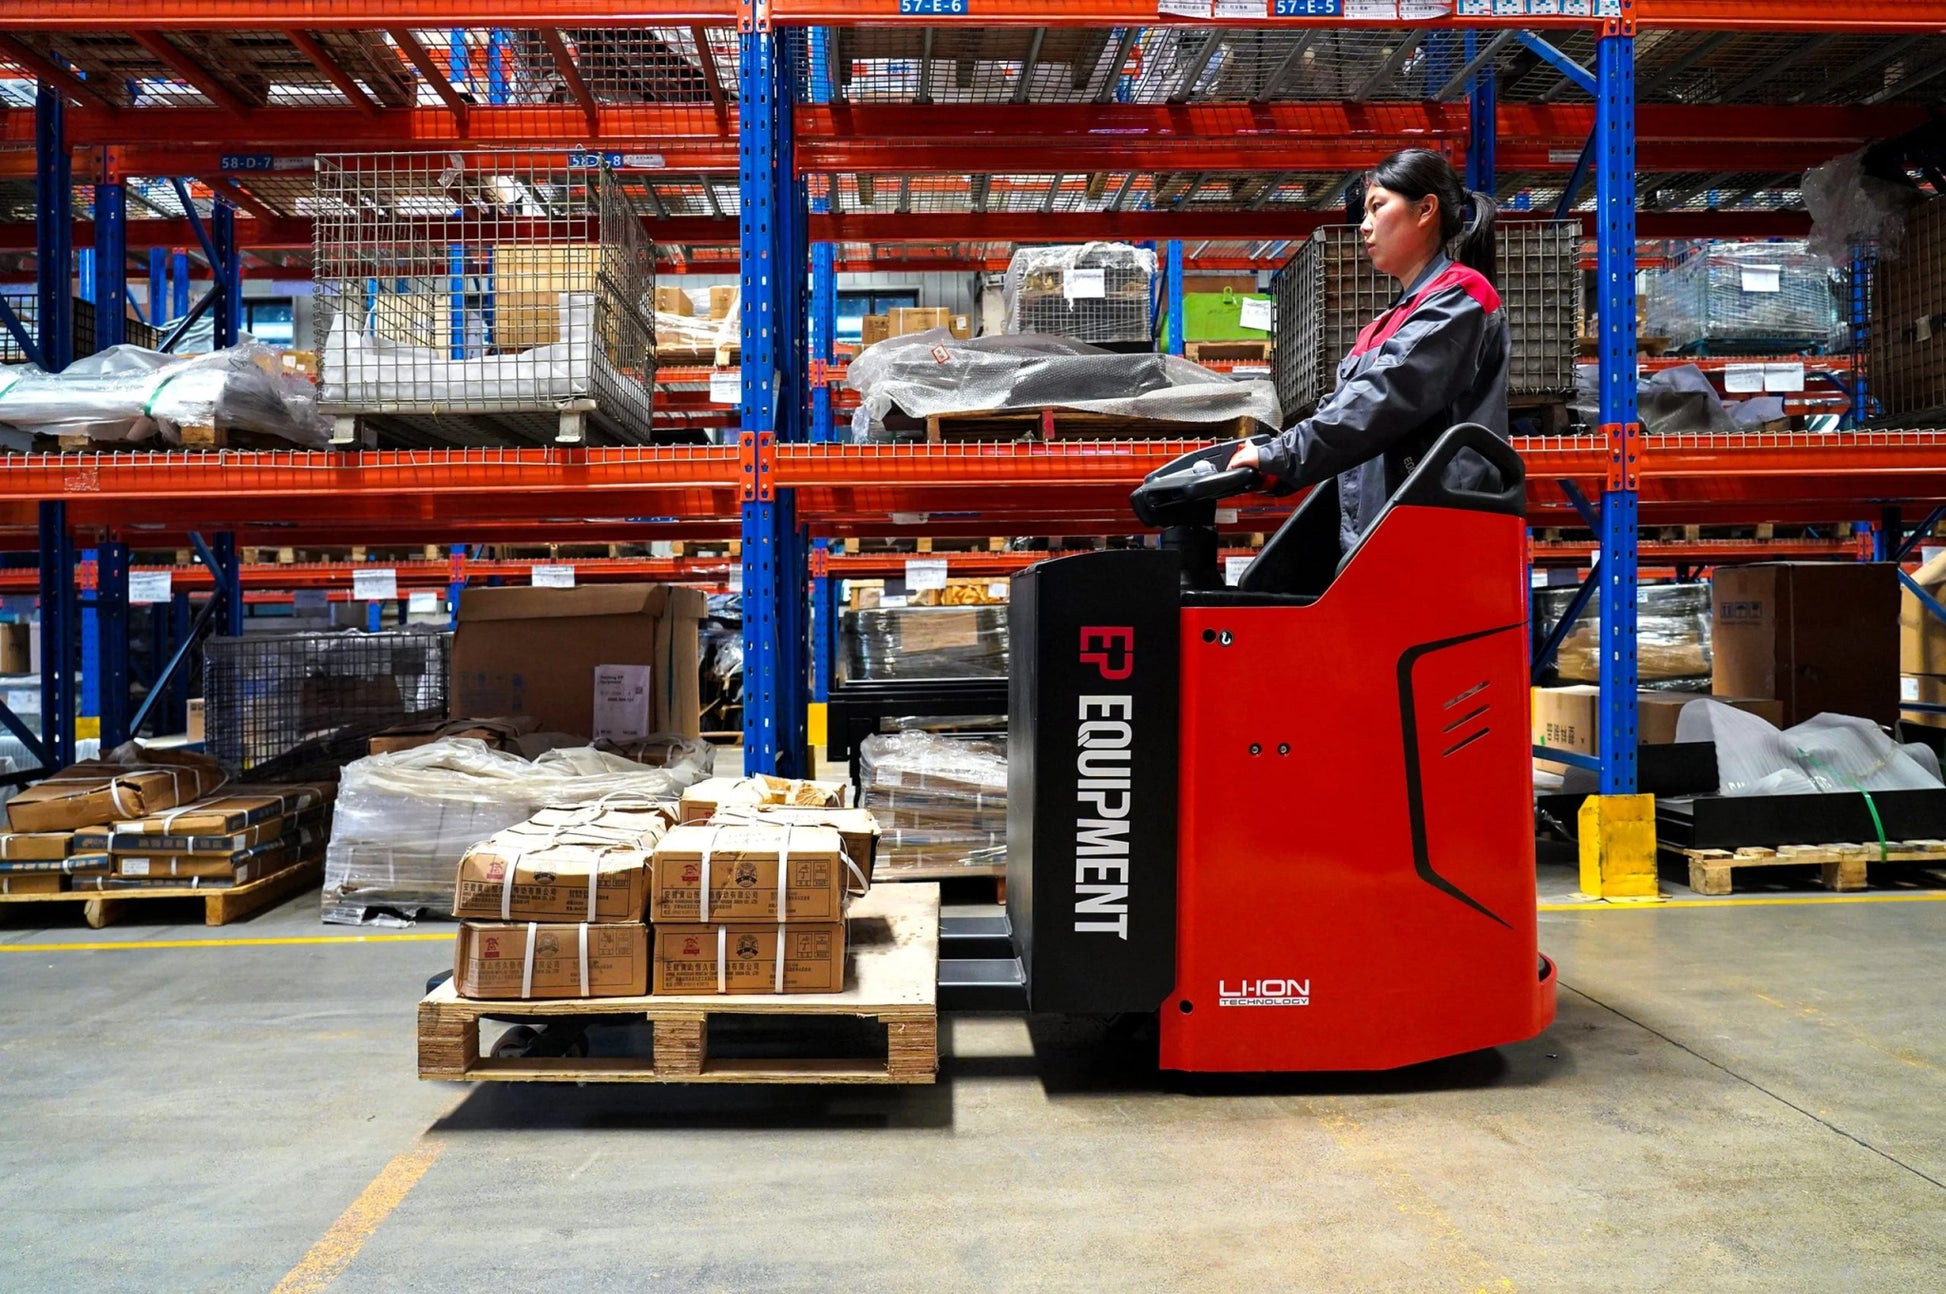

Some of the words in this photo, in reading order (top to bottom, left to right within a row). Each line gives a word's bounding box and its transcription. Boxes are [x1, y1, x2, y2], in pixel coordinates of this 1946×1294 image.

[902, 0, 961, 12] 57-E-6
[1277, 0, 1335, 13] 57-E-5
[222, 157, 272, 169] 58-D-7
[1080, 626, 1134, 680] EP
[1075, 695, 1133, 940] EQUIPMENT
[1219, 979, 1310, 996] LI-ION
[1220, 998, 1308, 1006] TECHNOLOGY
